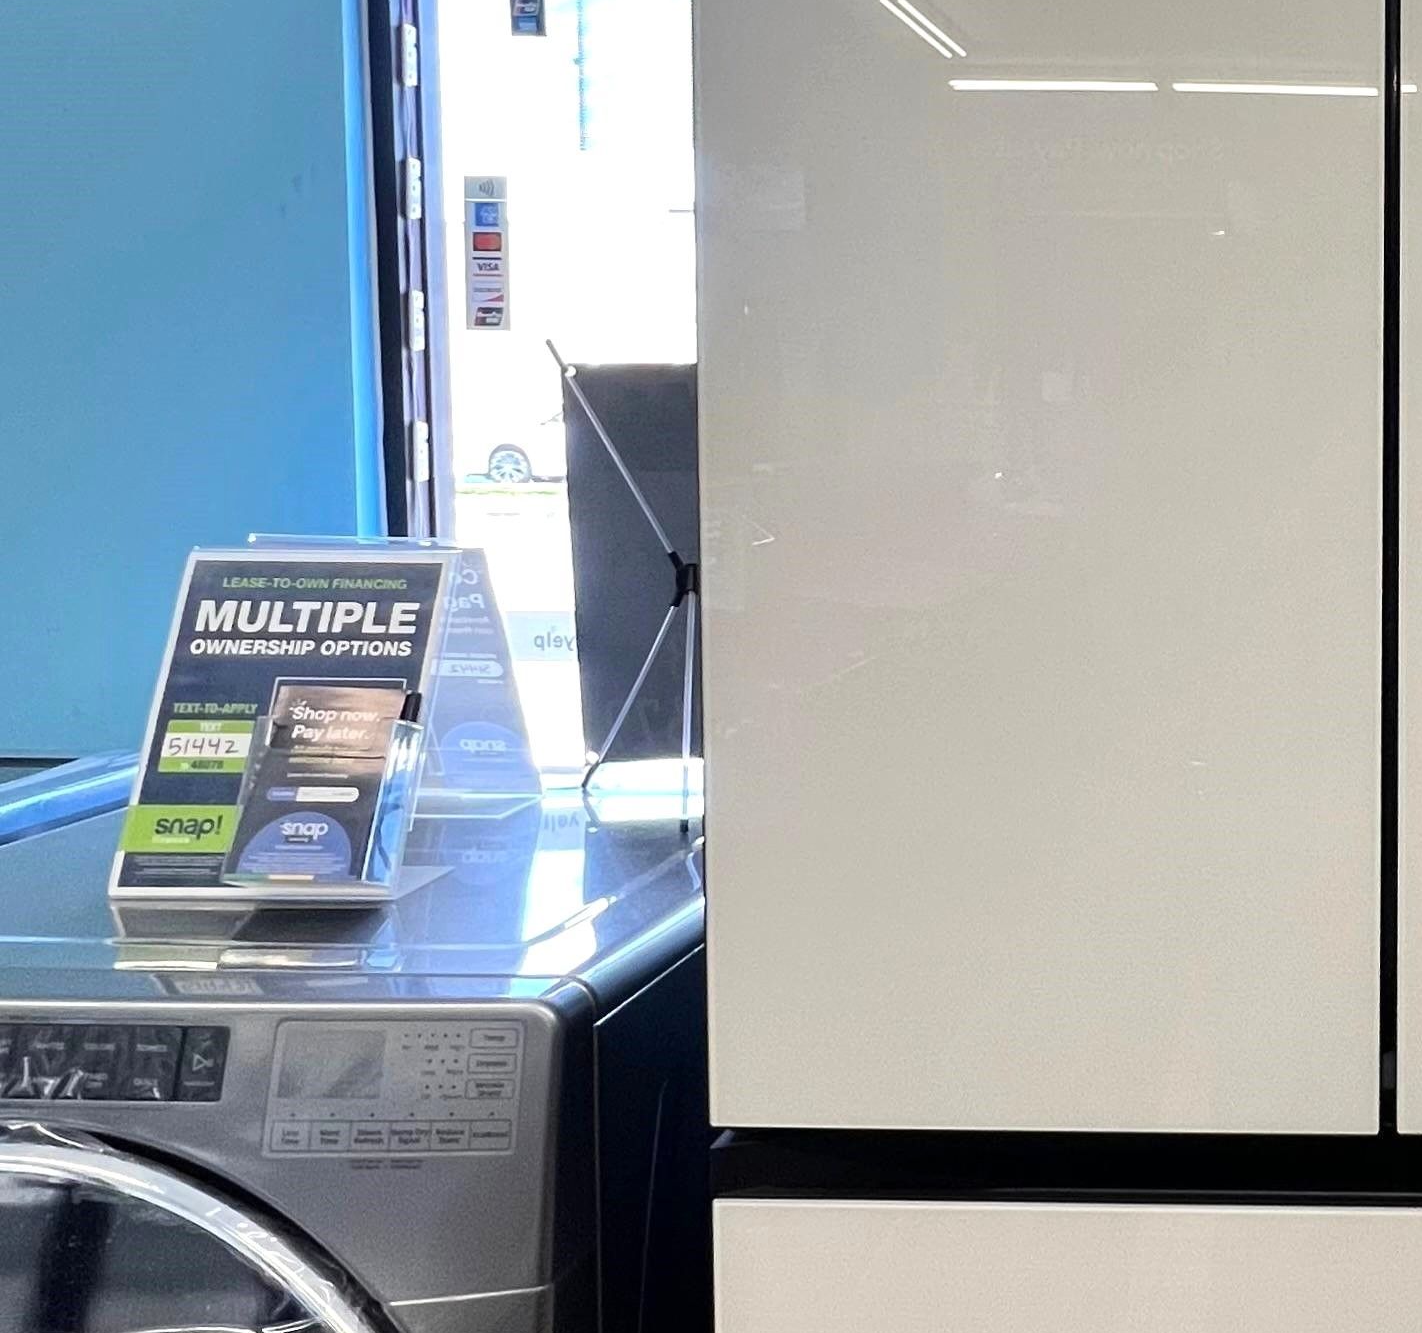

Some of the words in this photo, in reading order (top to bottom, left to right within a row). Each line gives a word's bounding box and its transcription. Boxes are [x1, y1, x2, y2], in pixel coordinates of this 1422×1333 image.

[476, 262, 500, 272] VISA
[223, 577, 330, 589] LEASE-TO-OWN
[332, 578, 408, 590] FINANCING
[195, 599, 421, 635] MULTIPLE
[190, 639, 316, 656] OWNERSHIP
[320, 640, 413, 657] OPTIONS
[291, 705, 338, 725] Shop
[340, 709, 381, 722] now.
[291, 724, 326, 743] Pay
[326, 725, 370, 740] later.
[168, 736, 240, 756] 51442
[154, 814, 223, 840] snap!
[281, 821, 329, 840] snap
